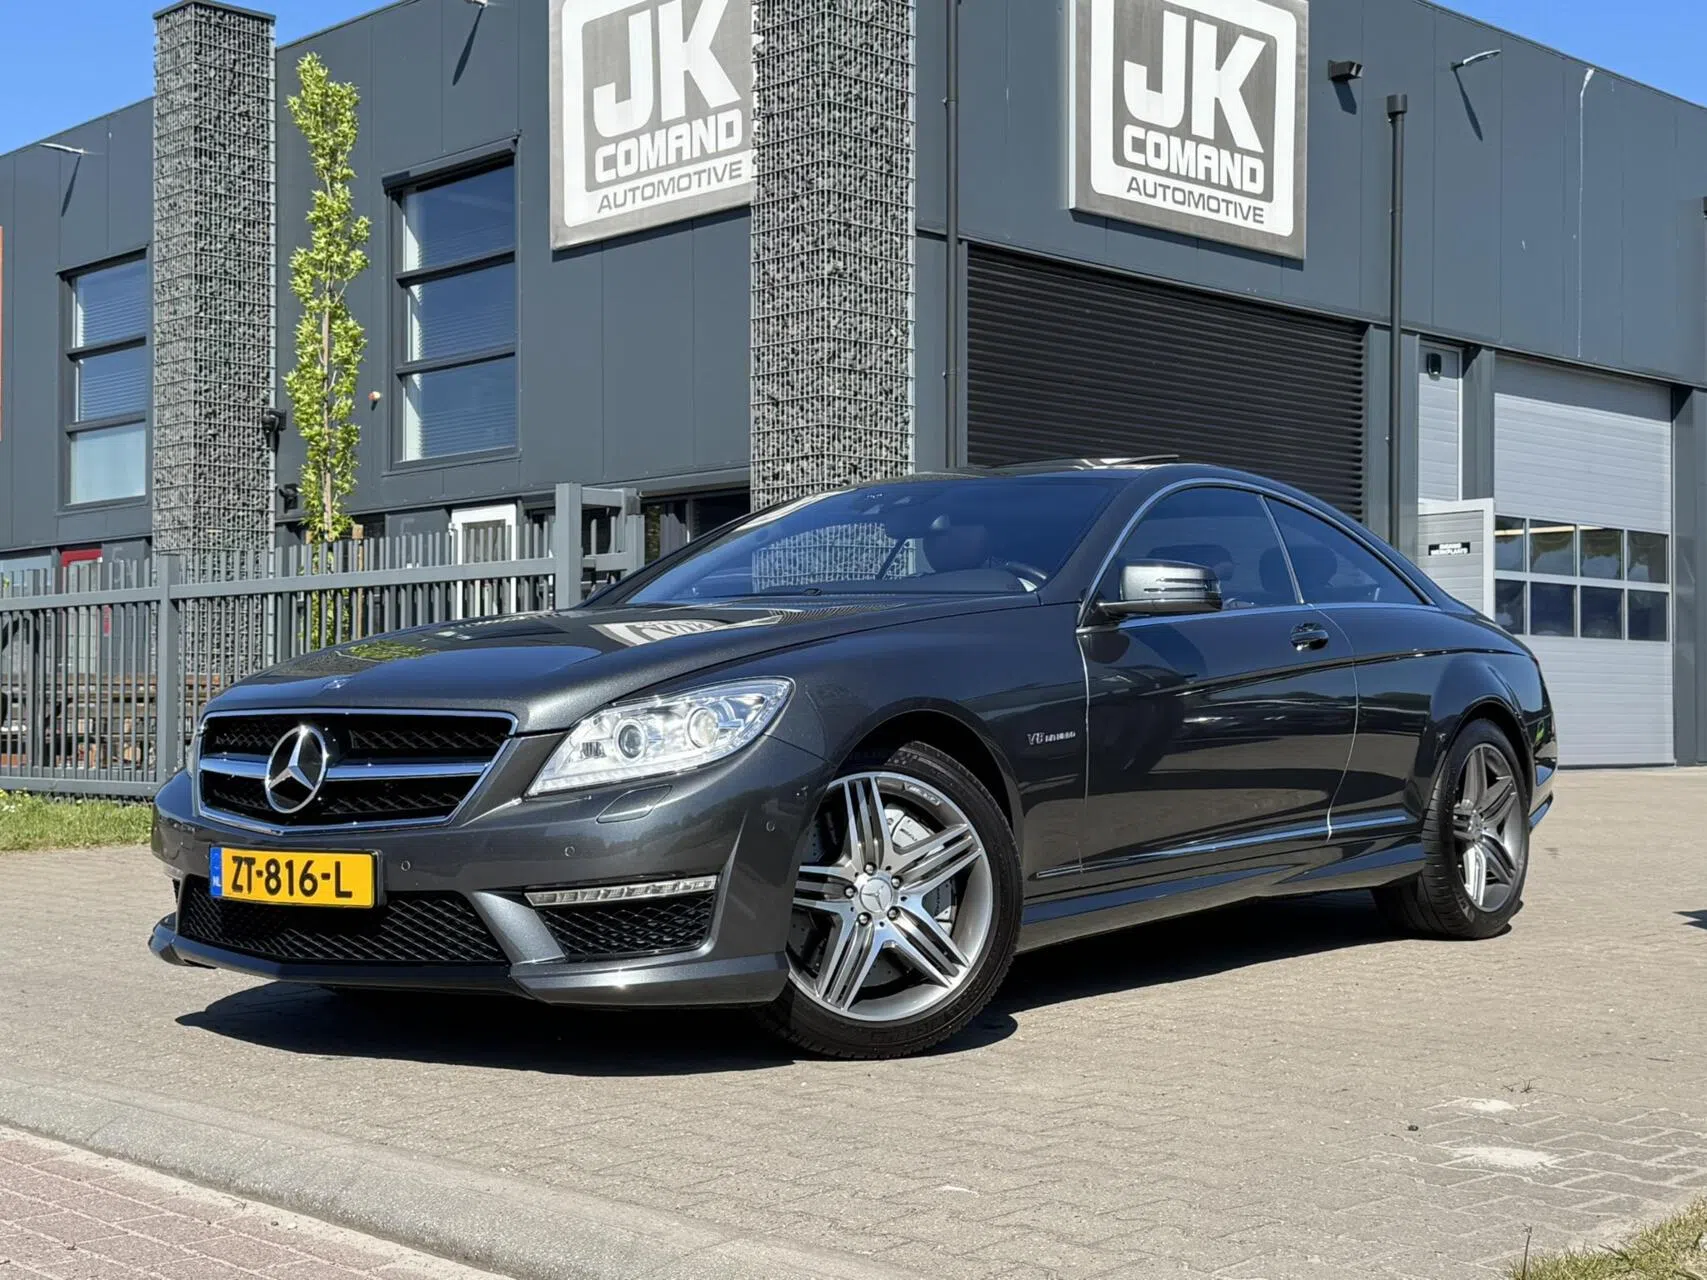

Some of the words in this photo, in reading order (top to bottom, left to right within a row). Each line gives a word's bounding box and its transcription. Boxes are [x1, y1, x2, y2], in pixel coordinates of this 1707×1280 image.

[593, 0, 742, 138] JK
[1123, 9, 1267, 154] JK
[595, 108, 743, 184] COMAND
[1123, 124, 1265, 195] COMAND
[597, 160, 743, 214] AUTOMOTIVE
[1126, 176, 1265, 225] AUTOMOTIVE
[231, 855, 353, 899] ZT-816-L
